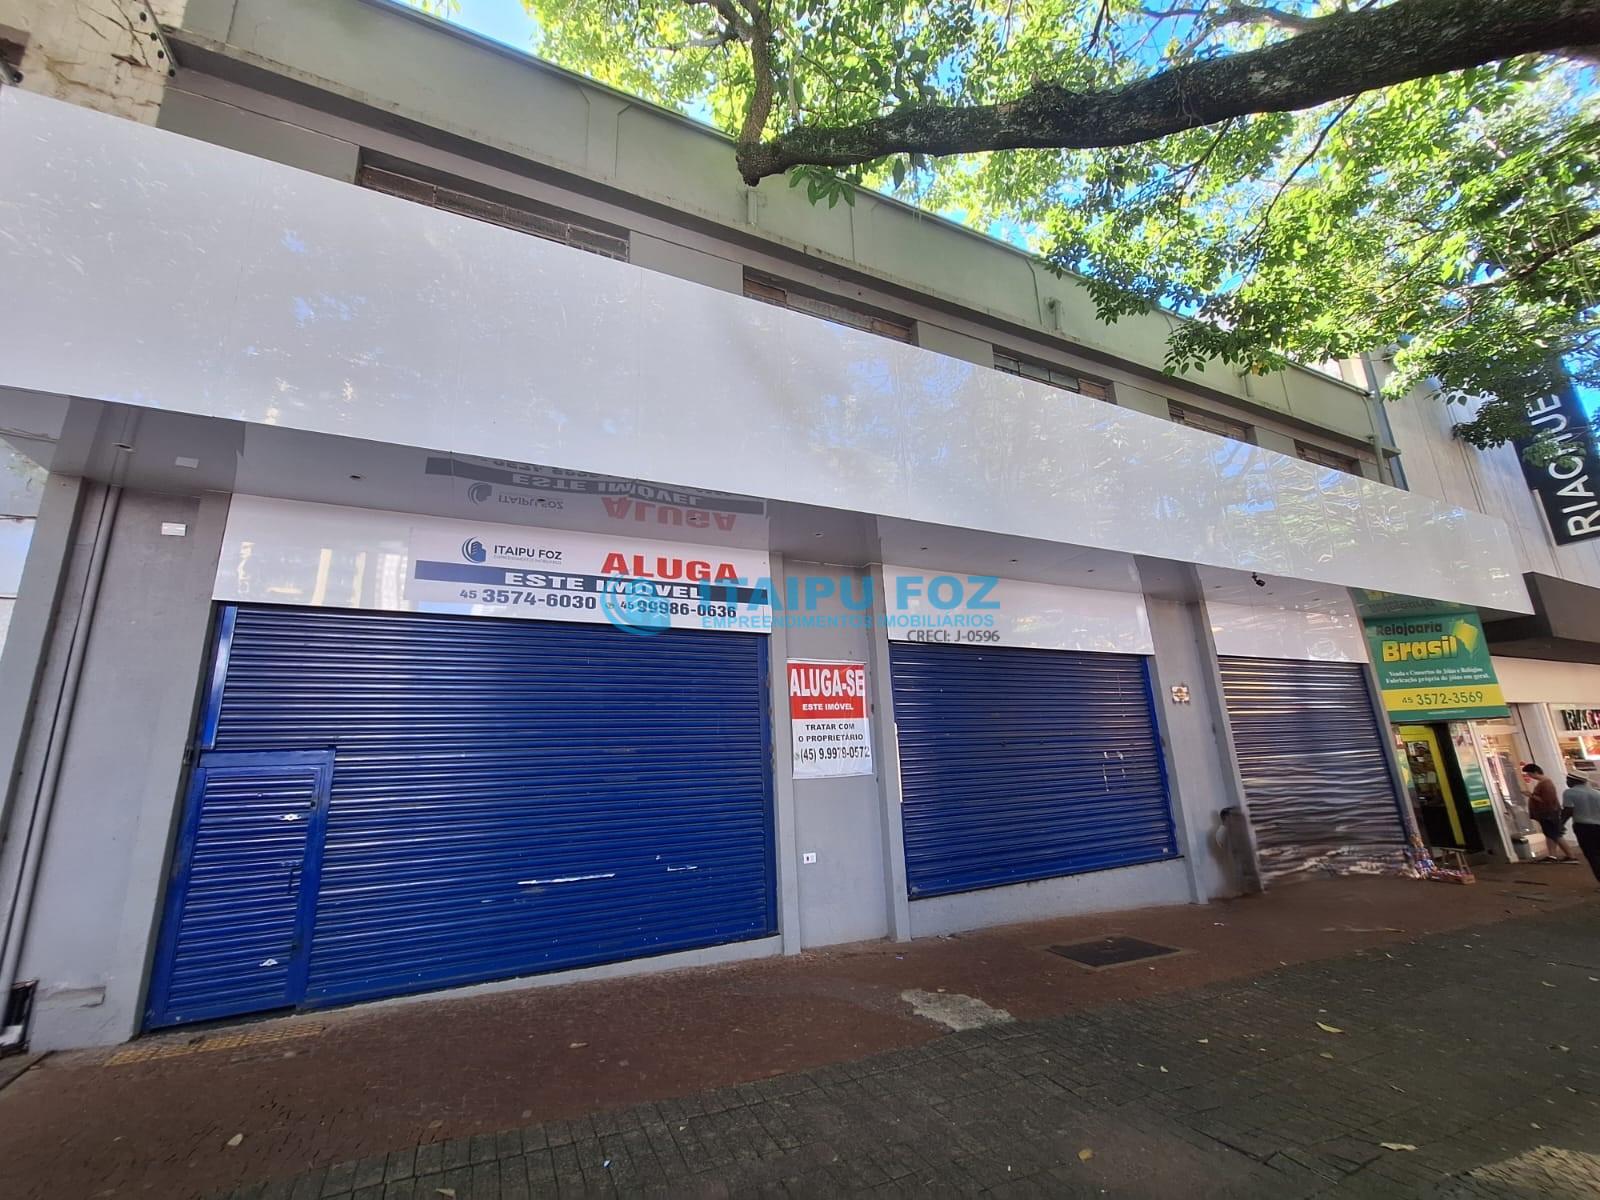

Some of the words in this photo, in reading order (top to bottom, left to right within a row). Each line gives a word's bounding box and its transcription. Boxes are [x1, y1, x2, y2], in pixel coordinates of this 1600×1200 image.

[494, 545, 535, 557] ITAIPU
[538, 549, 562, 561] FOZ
[601, 552, 740, 584] ALUGA
[504, 571, 584, 590] ESTE
[460, 589, 477, 599] 45
[482, 588, 597, 610] 3574-6030
[620, 601, 634, 610] 45
[637, 600, 737, 618] 99986-0636
[1382, 635, 1458, 662] Brasil
[790, 668, 865, 697] ALUGA-SE
[802, 703, 823, 711] ESTE
[825, 702, 854, 711] IMÓVEL
[1402, 696, 1413, 704] 45
[1416, 691, 1483, 706] 3572-3569
[805, 723, 836, 731] TRATAR
[800, 748, 817, 763] (45)
